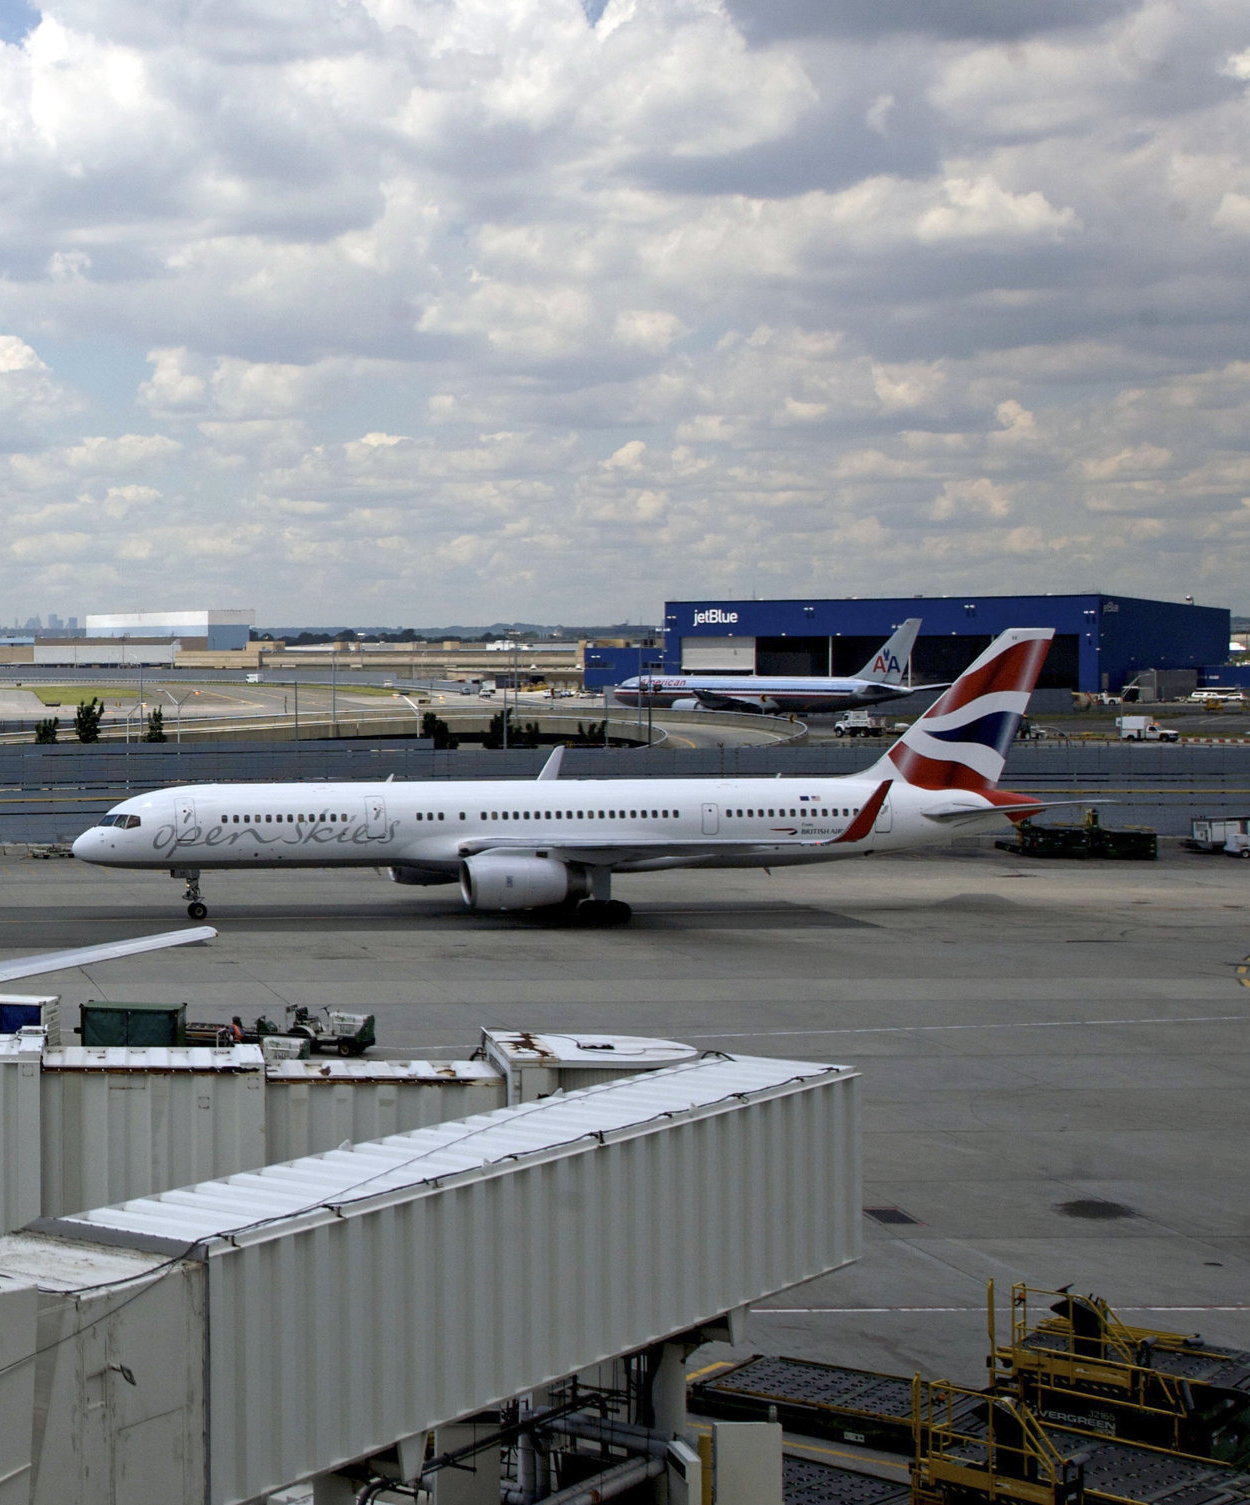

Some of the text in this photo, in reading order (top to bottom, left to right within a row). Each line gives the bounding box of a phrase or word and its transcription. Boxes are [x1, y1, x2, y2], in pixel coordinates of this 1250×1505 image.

[693, 609, 738, 627] jetBlue
[873, 656, 900, 673] AA
[282, 808, 400, 845] skies
